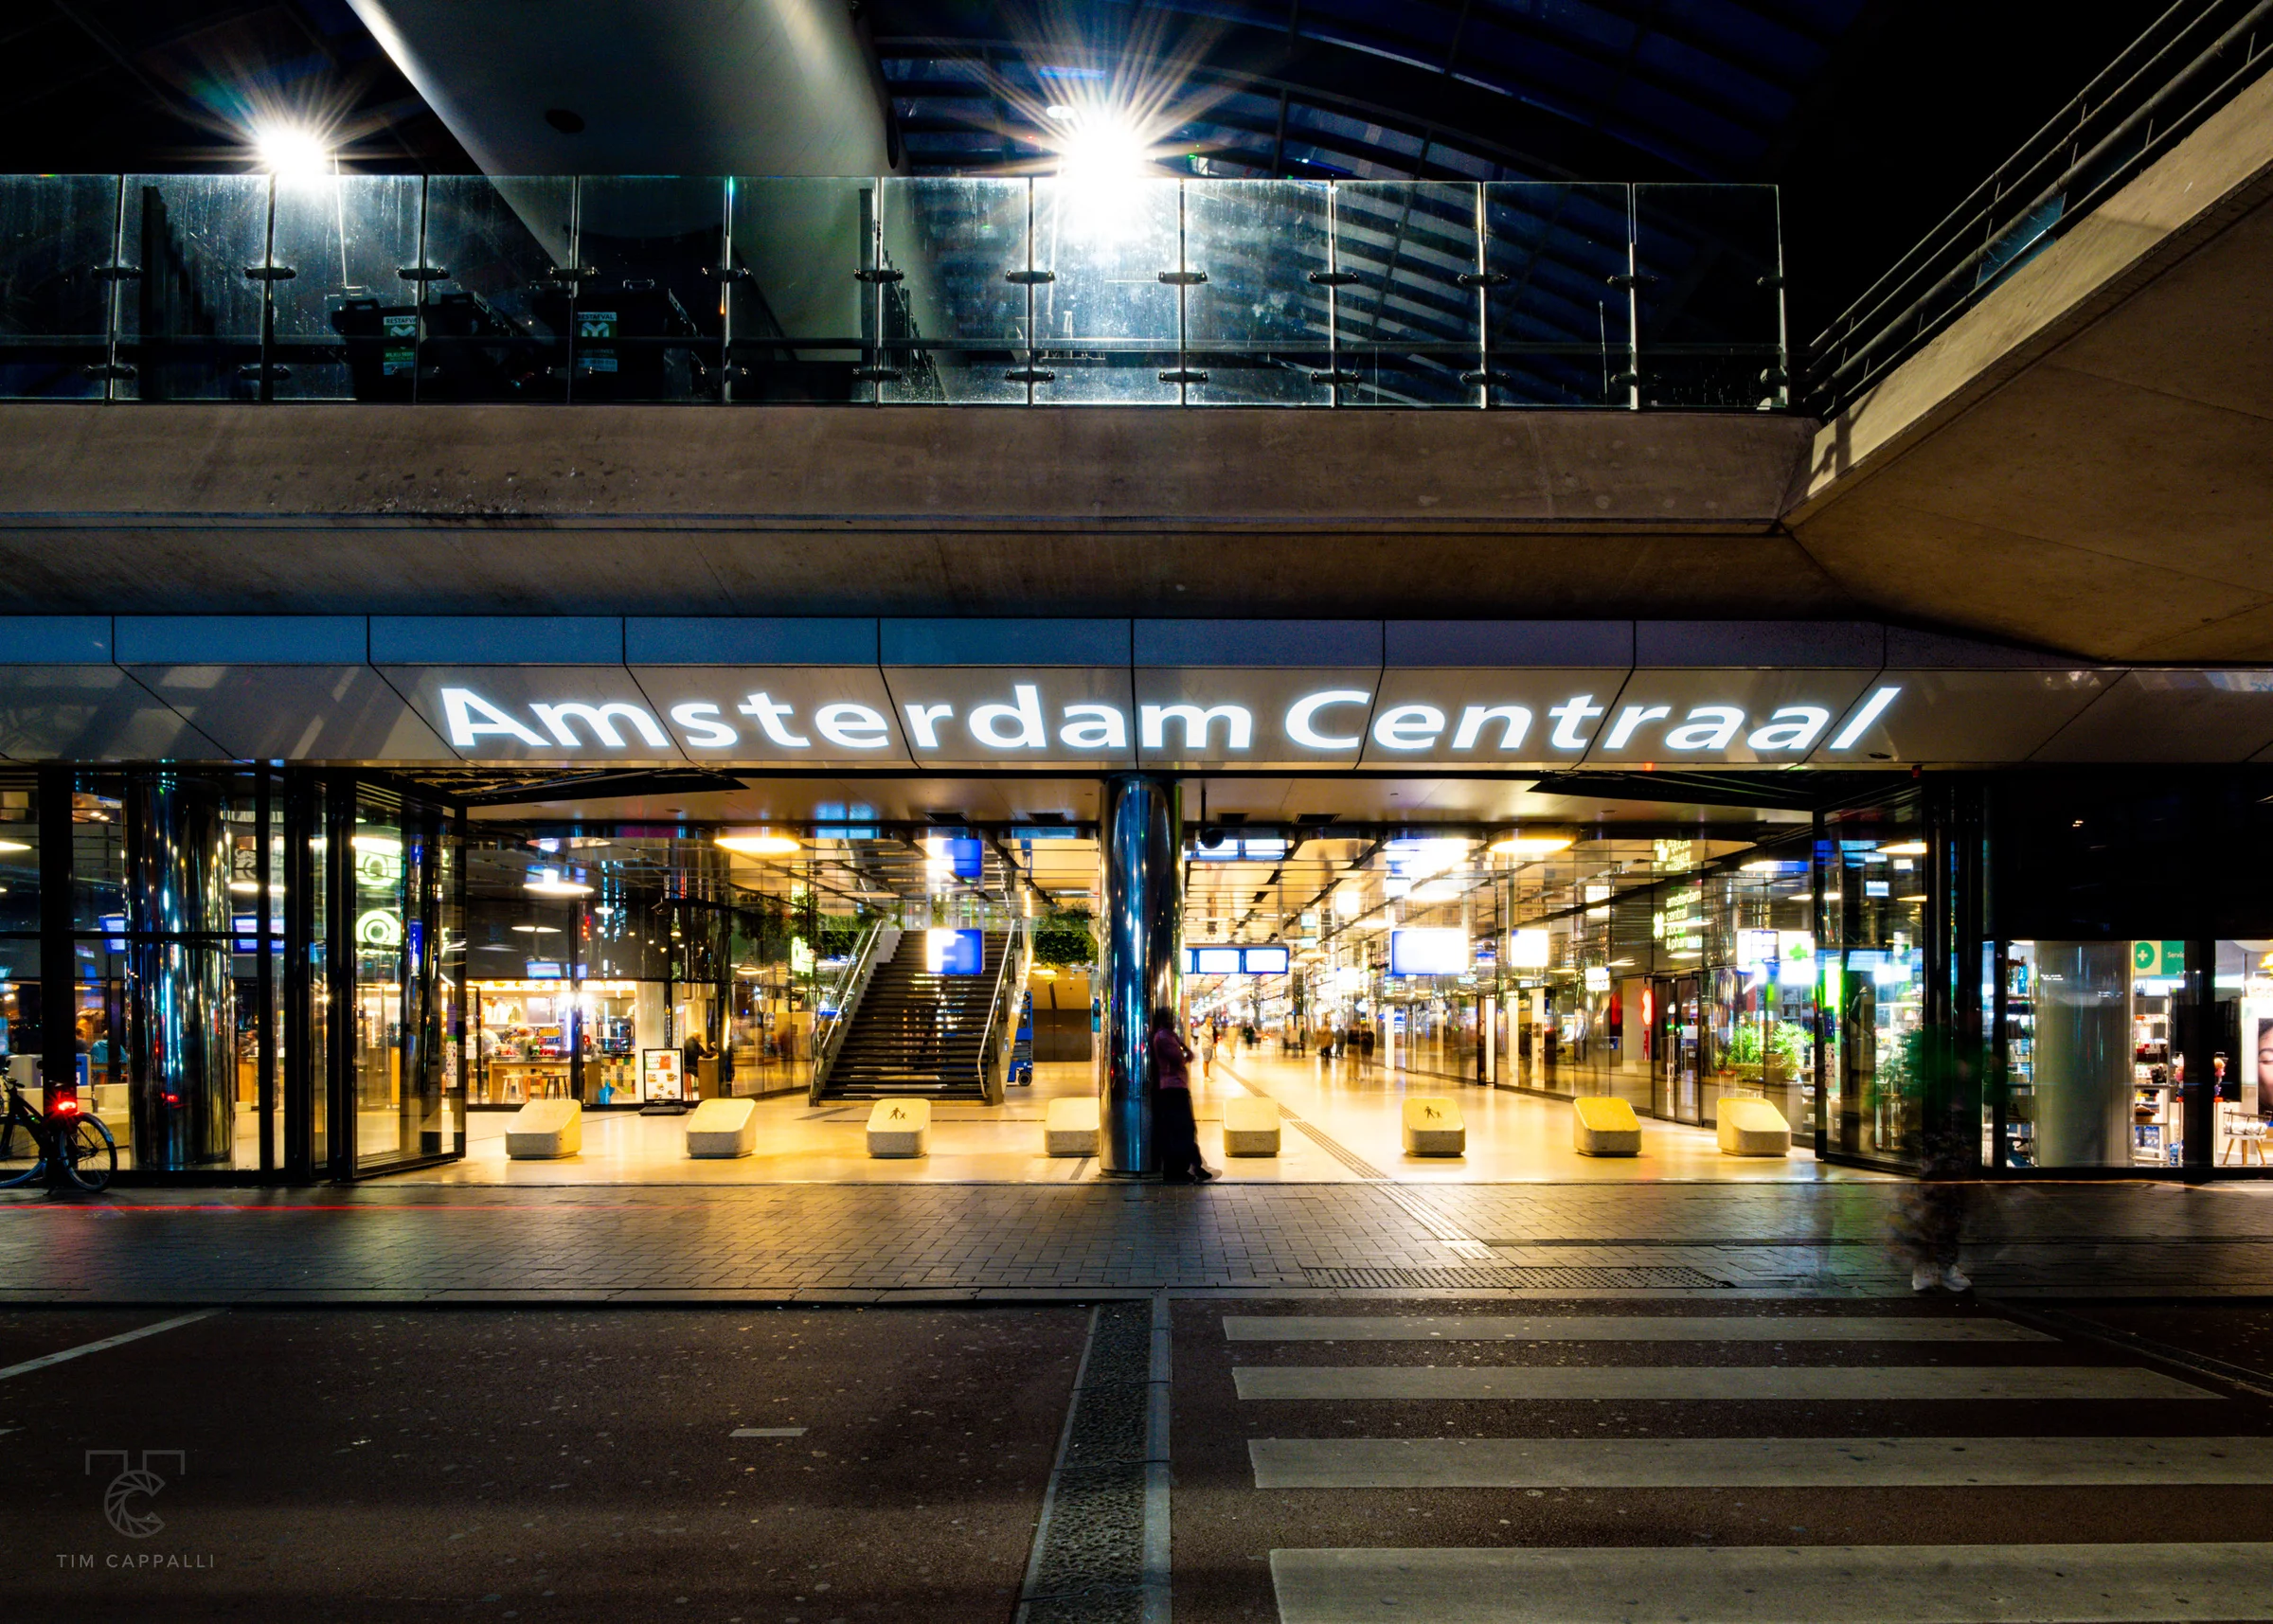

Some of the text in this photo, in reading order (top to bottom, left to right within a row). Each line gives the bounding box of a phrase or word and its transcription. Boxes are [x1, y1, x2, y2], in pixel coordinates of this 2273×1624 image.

[441, 686, 1901, 750] Amsterdam Centraal
[1666, 889, 1702, 908] amsterdam
[1666, 904, 1688, 922] central
[1666, 937, 1672, 950] &
